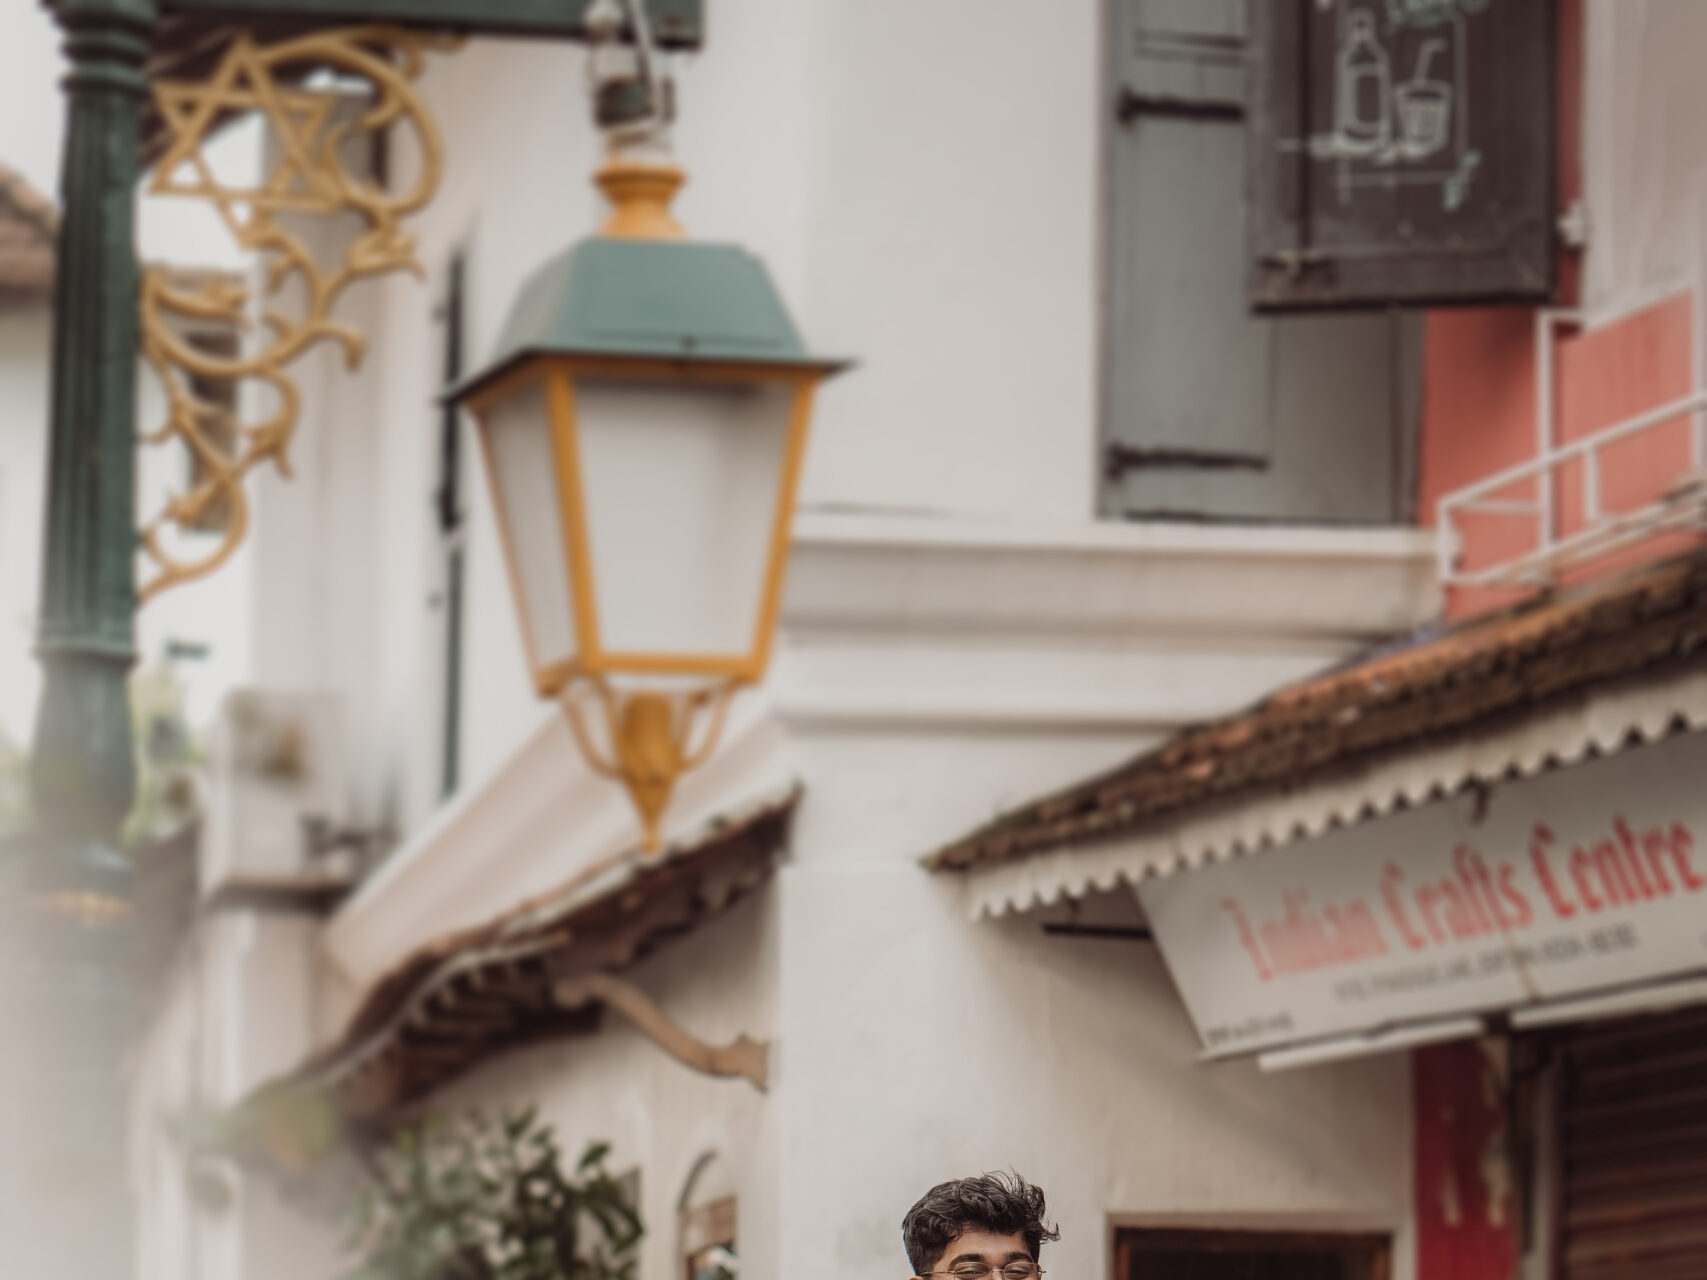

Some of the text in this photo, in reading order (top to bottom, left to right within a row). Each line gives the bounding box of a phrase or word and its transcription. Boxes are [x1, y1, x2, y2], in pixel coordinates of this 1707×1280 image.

[1221, 886, 1390, 982] Indian
[1379, 842, 1534, 951] Crafts
[1528, 814, 1706, 919] Centre
